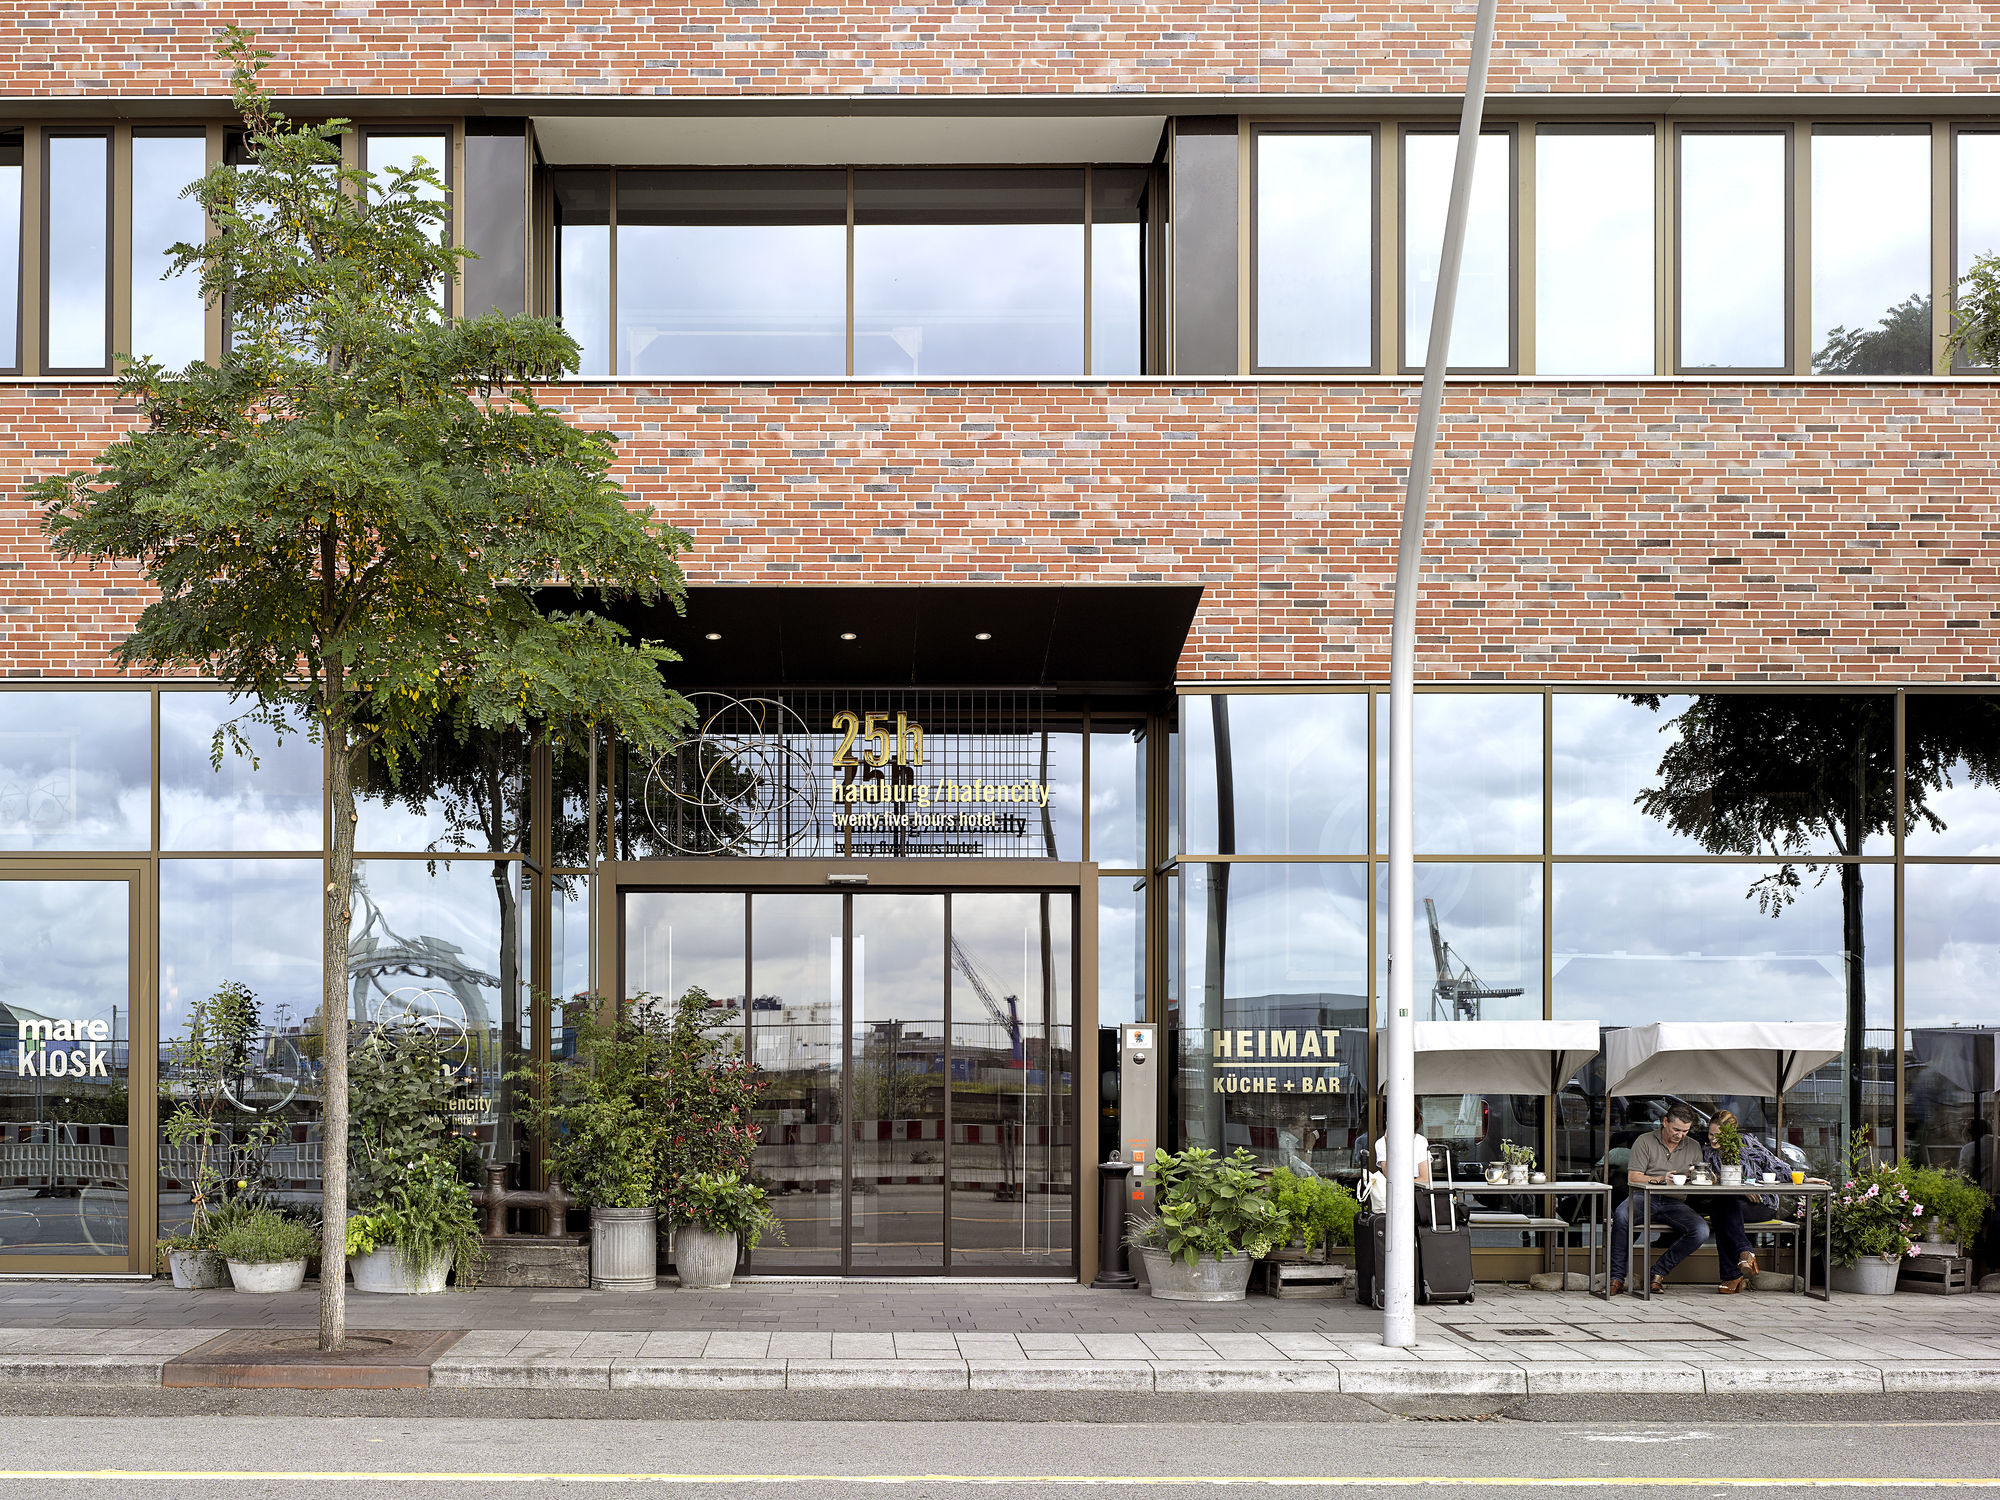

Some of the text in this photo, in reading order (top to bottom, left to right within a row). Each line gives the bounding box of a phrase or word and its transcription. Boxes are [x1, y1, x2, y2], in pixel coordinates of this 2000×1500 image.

[832, 710, 924, 767] 25h
[832, 811, 880, 830] twenty
[884, 811, 910, 827] five
[914, 811, 955, 827] hours
[959, 811, 996, 827] hotel
[19, 1019, 109, 1041] mare
[1213, 1030, 1340, 1057] HEIMAT
[19, 1041, 108, 1077] kiosk
[1213, 1073, 1340, 1093] KÜCHE + BAR
